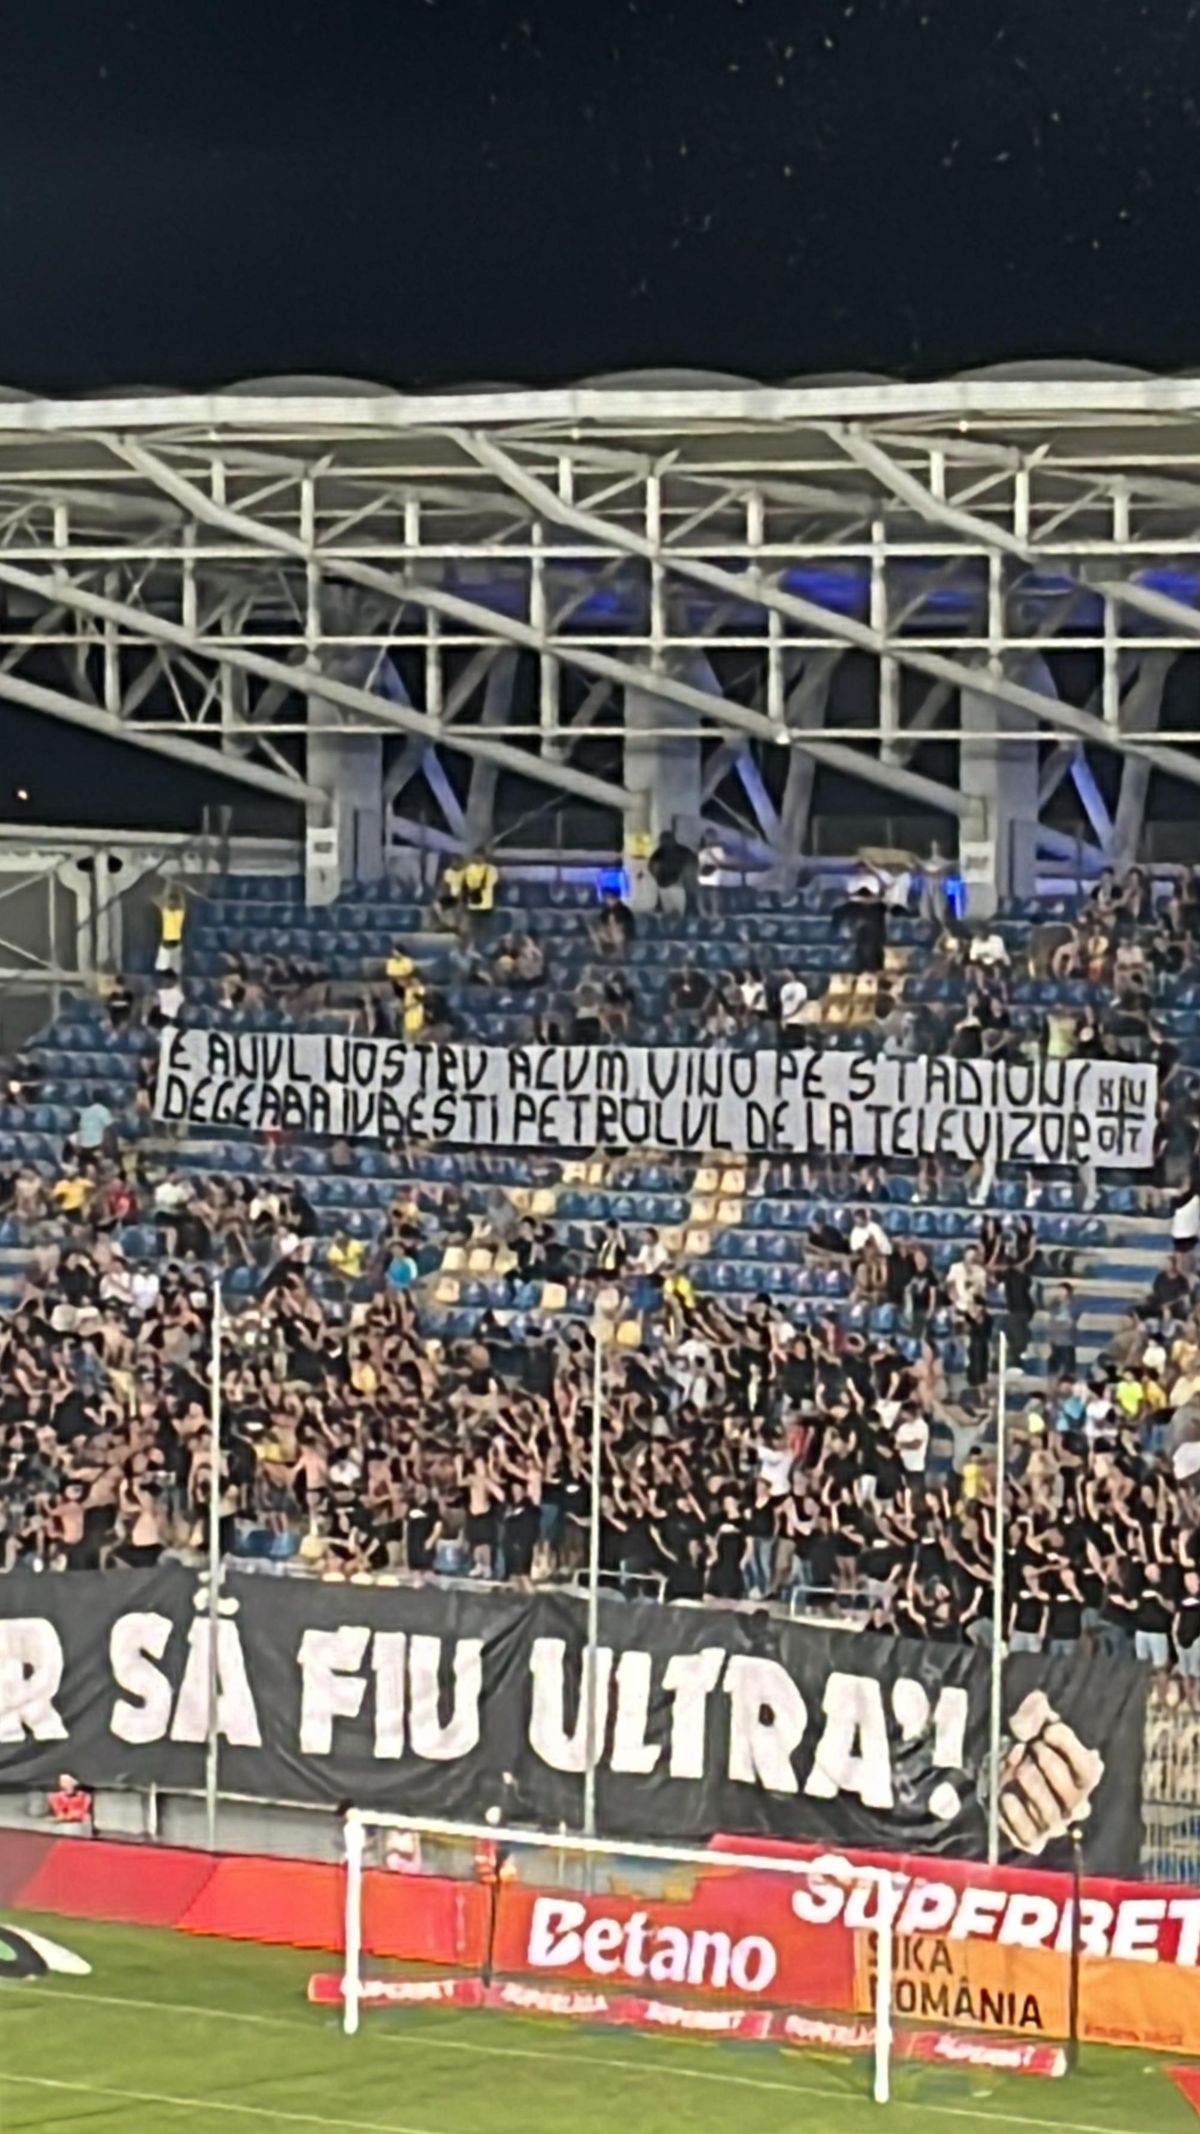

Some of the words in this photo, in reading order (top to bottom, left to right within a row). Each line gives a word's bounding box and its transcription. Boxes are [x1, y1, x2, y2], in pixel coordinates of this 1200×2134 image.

[647, 1049, 757, 1098] VINO
[775, 1050, 826, 1099] PE
[746, 1100, 794, 1150] DE
[805, 1100, 854, 1152] LA
[298, 1625, 484, 1761] FIU
[527, 1897, 777, 1992] Betano
